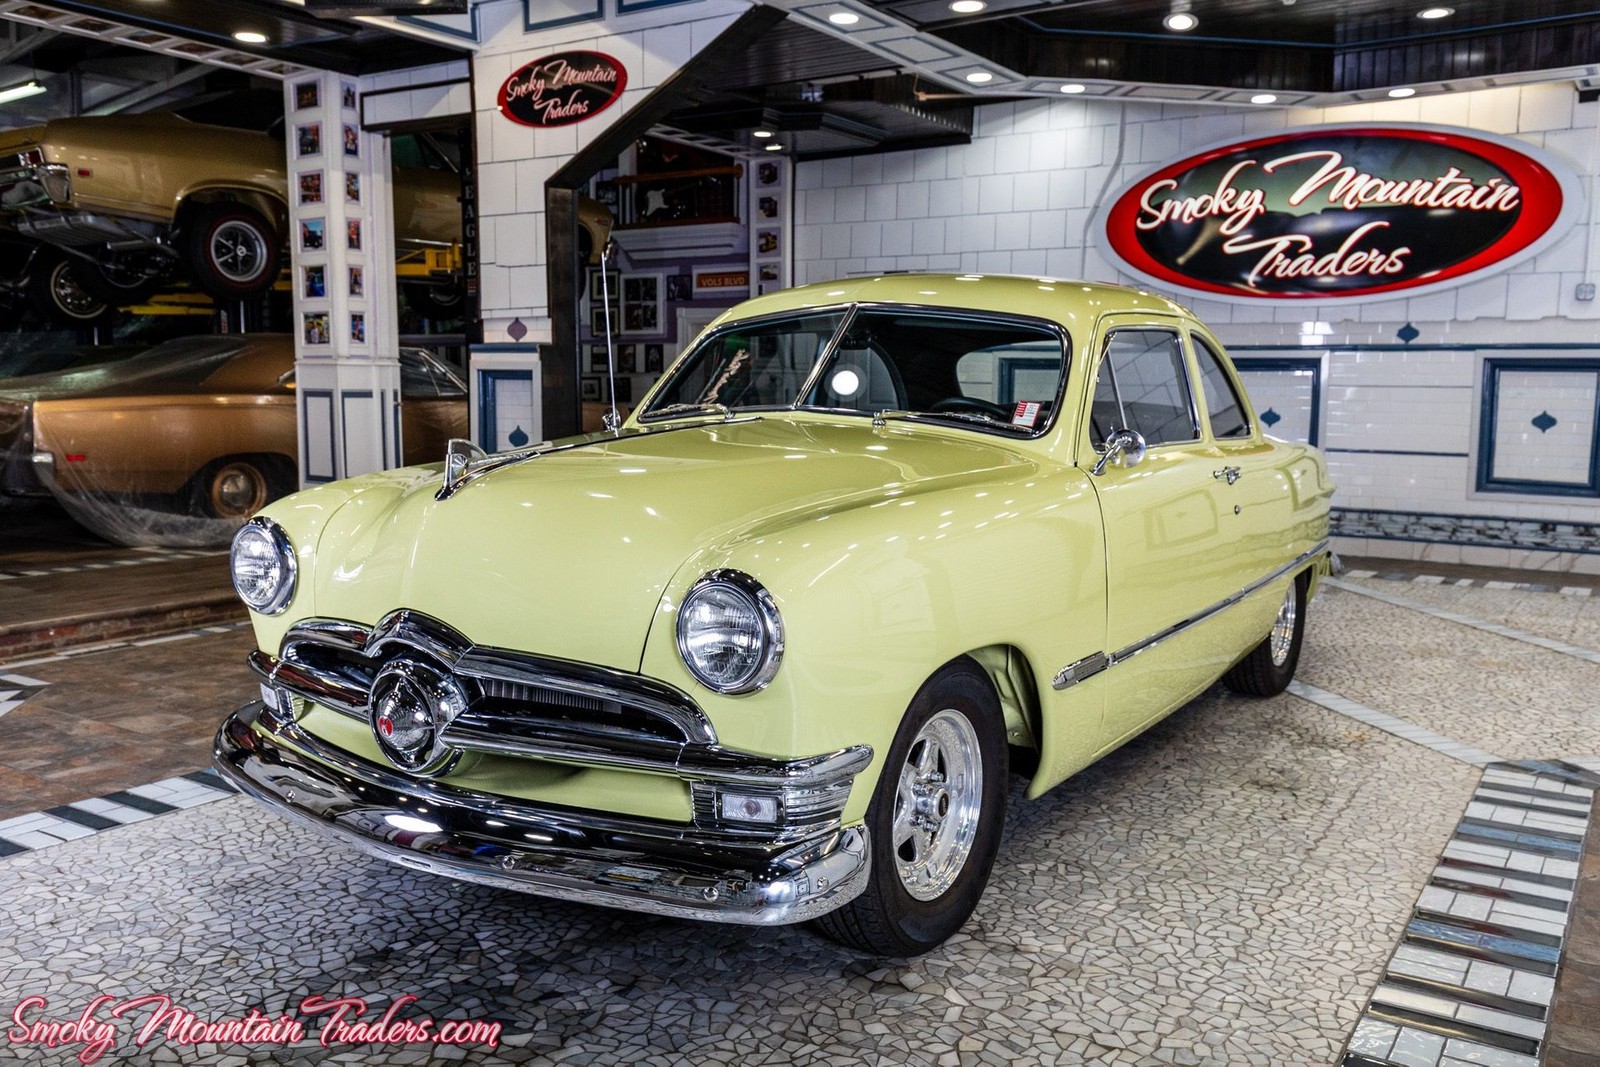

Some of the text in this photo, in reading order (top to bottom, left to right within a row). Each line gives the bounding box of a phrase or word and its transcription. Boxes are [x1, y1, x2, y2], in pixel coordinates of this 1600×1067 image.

[506, 59, 618, 102] Smoky Mountain
[533, 89, 590, 125] Traders
[1136, 150, 1522, 236] Smoky Mountain
[464, 185, 477, 277] EAGLE
[1222, 220, 1411, 288] Traders
[701, 276, 745, 287] VOLS BLVD
